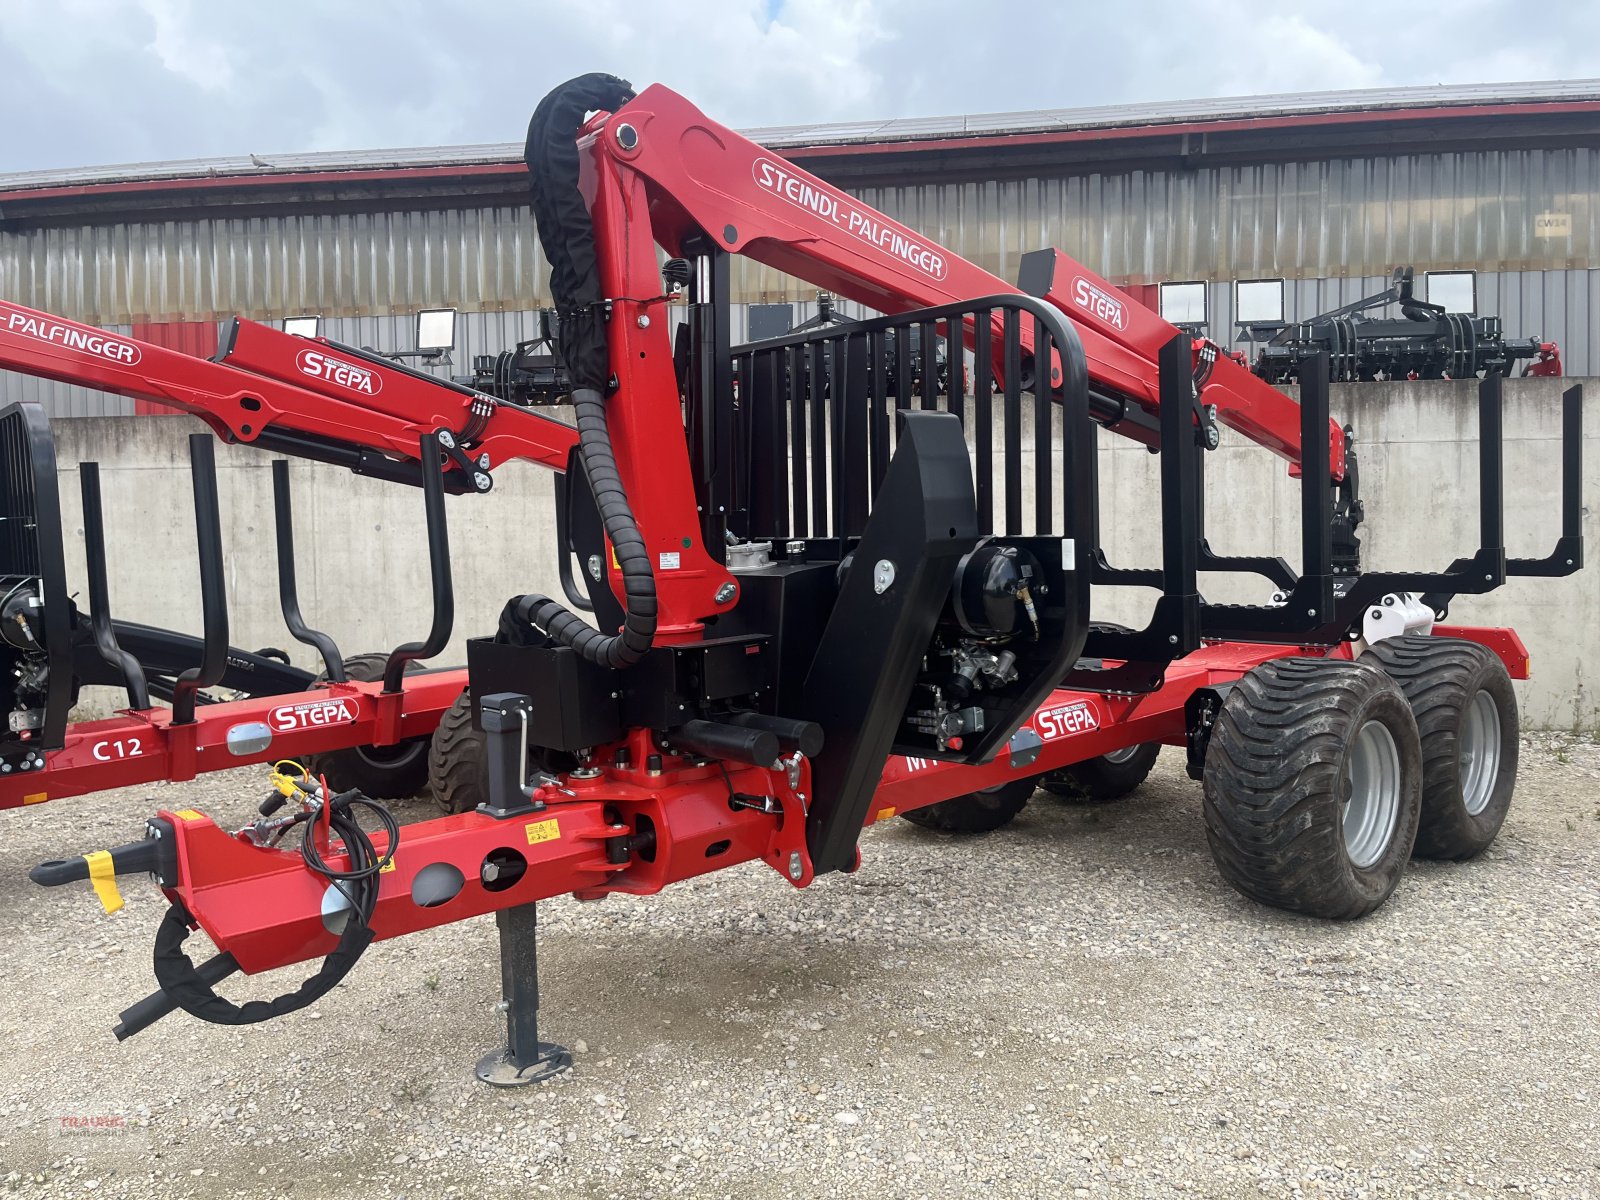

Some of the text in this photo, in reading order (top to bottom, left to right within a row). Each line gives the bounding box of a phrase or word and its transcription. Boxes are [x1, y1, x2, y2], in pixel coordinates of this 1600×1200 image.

[760, 163, 942, 277] STEINDL-PALFINGER
[1076, 280, 1122, 329] STEPA
[303, 352, 372, 394] STEPA
[276, 705, 352, 730] STEPA
[1038, 708, 1097, 739] STEPA
